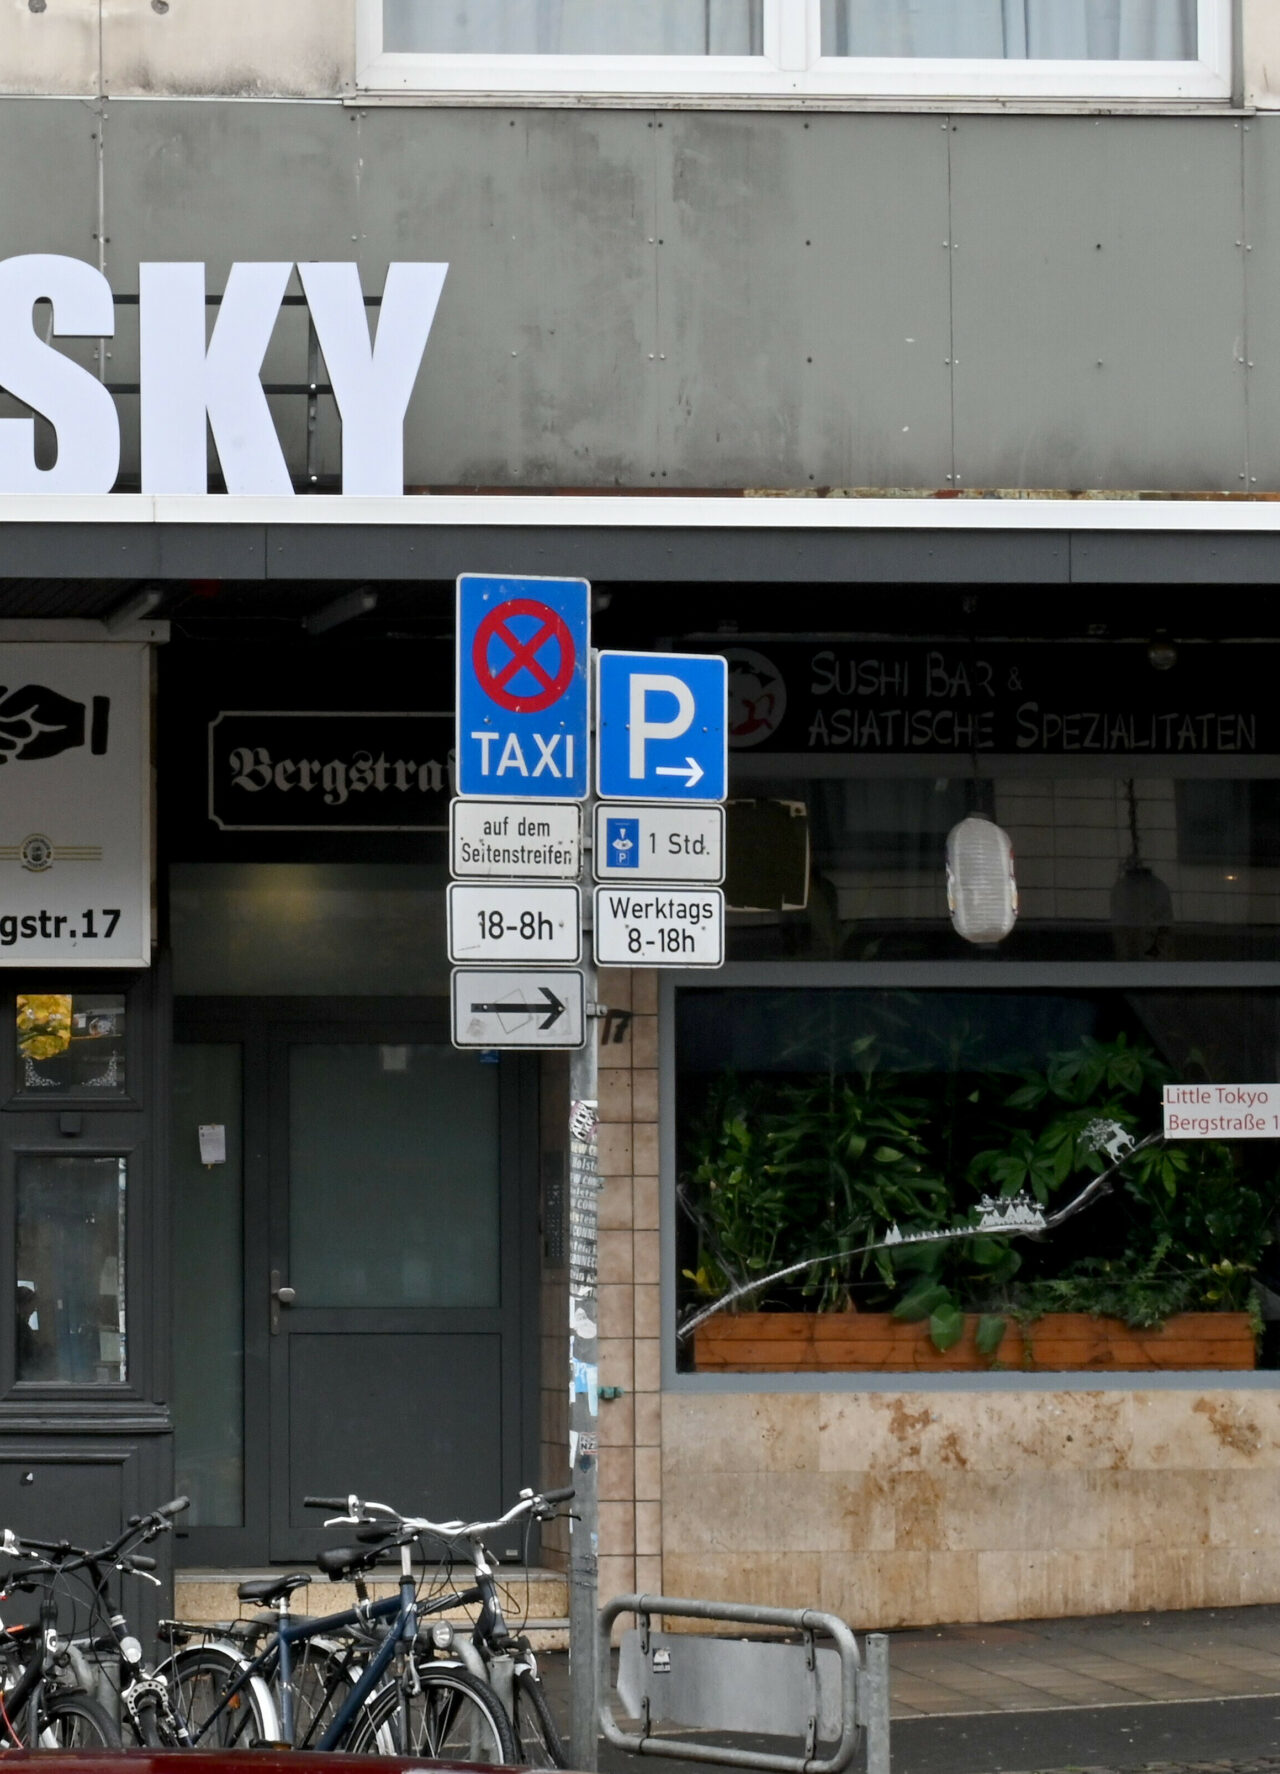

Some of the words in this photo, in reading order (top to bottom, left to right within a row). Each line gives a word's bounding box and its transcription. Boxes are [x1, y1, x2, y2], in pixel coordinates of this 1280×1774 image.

[629, 672, 696, 780] P
[471, 731, 575, 779] TAXI
[228, 747, 456, 806] Bergstra
[483, 816, 511, 838] auf
[517, 816, 551, 838] dem
[461, 843, 573, 866] Seitenstreifen
[649, 832, 657, 855] 1
[668, 832, 711, 856] Std.
[479, 910, 554, 941] 18-8h
[609, 896, 714, 926] Werktags
[627, 927, 696, 955] 8-18h
[600, 1008, 634, 1046] 17
[1166, 1087, 1212, 1104] Little
[1215, 1087, 1269, 1109] Tokyo
[1168, 1113, 1266, 1135] Bergstraße
